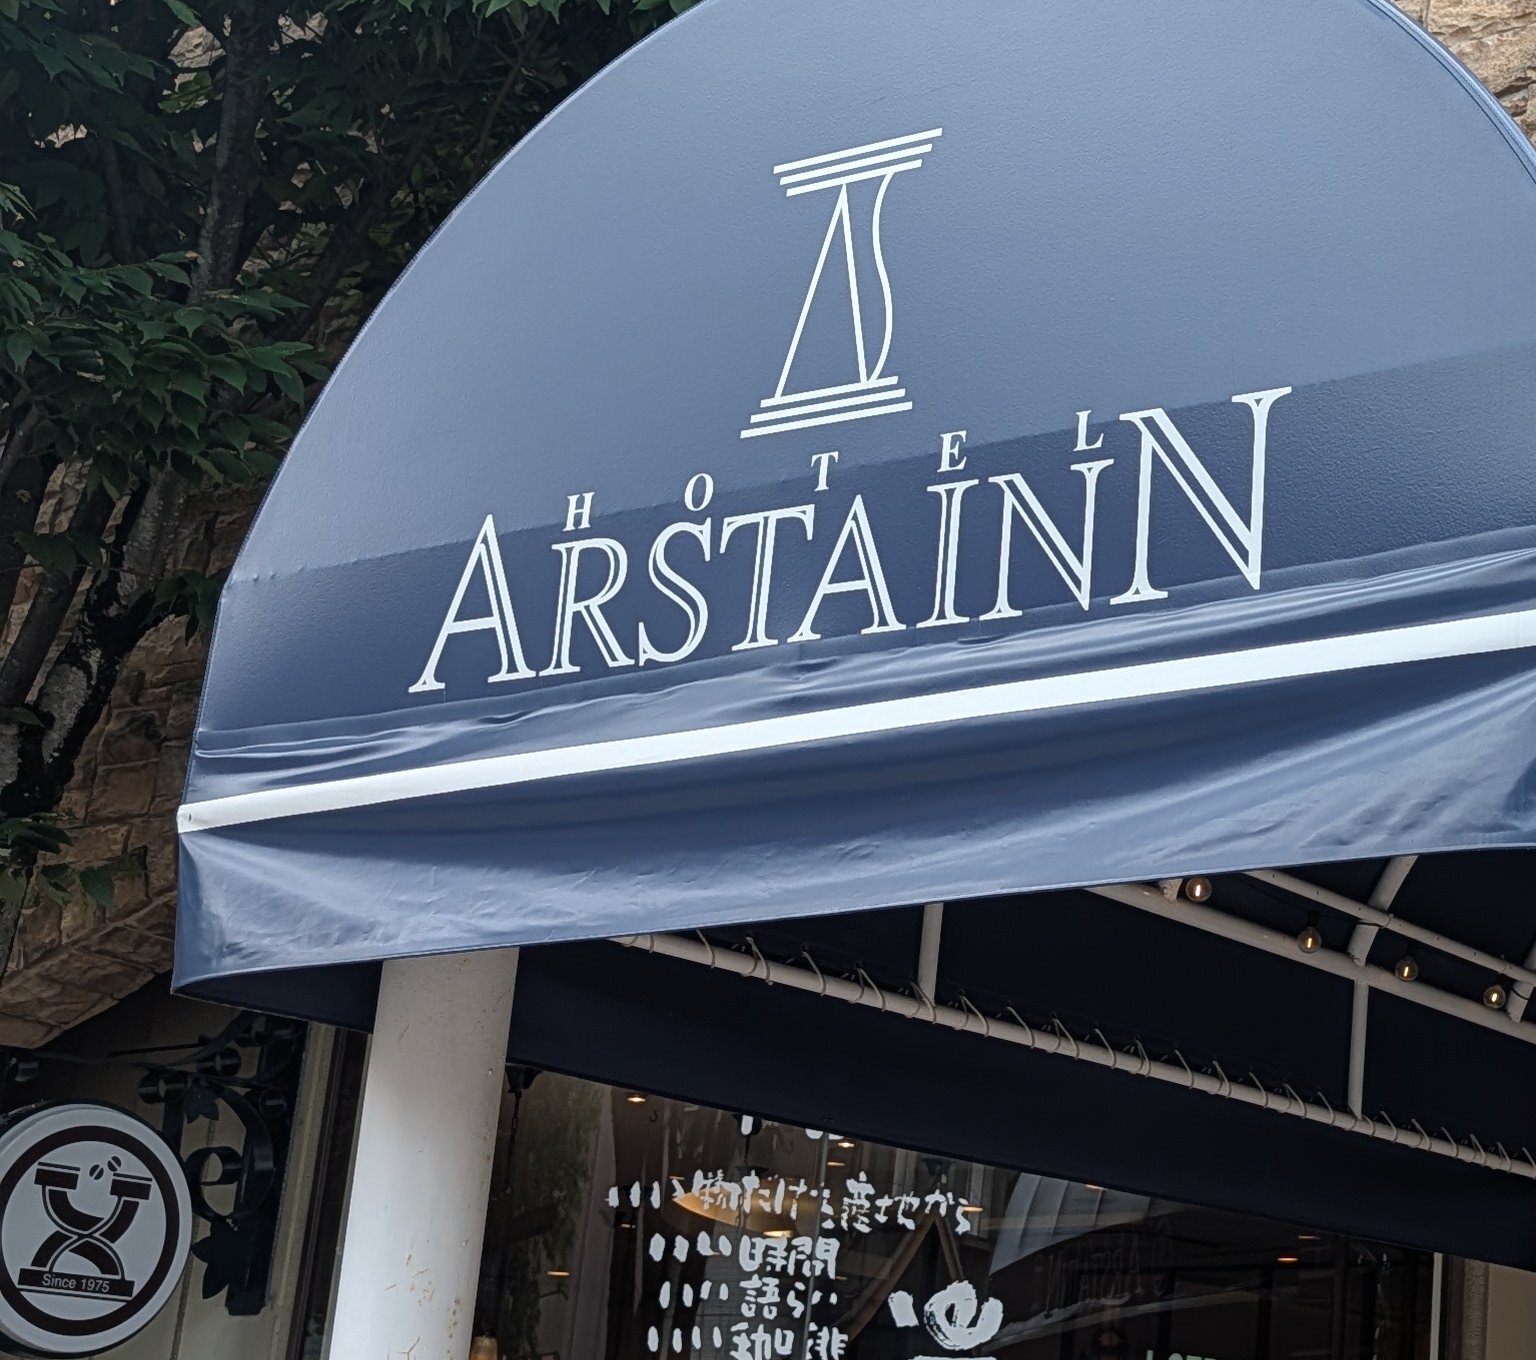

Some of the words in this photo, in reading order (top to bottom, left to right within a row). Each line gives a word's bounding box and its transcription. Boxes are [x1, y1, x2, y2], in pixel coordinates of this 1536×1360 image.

[565, 410, 1105, 531] HOTEL
[408, 386, 1293, 694] ARSTAINN
[41, 1273, 77, 1289] Since
[81, 1278, 110, 1293] 1975
[649, 1230, 841, 1280] いい時間
